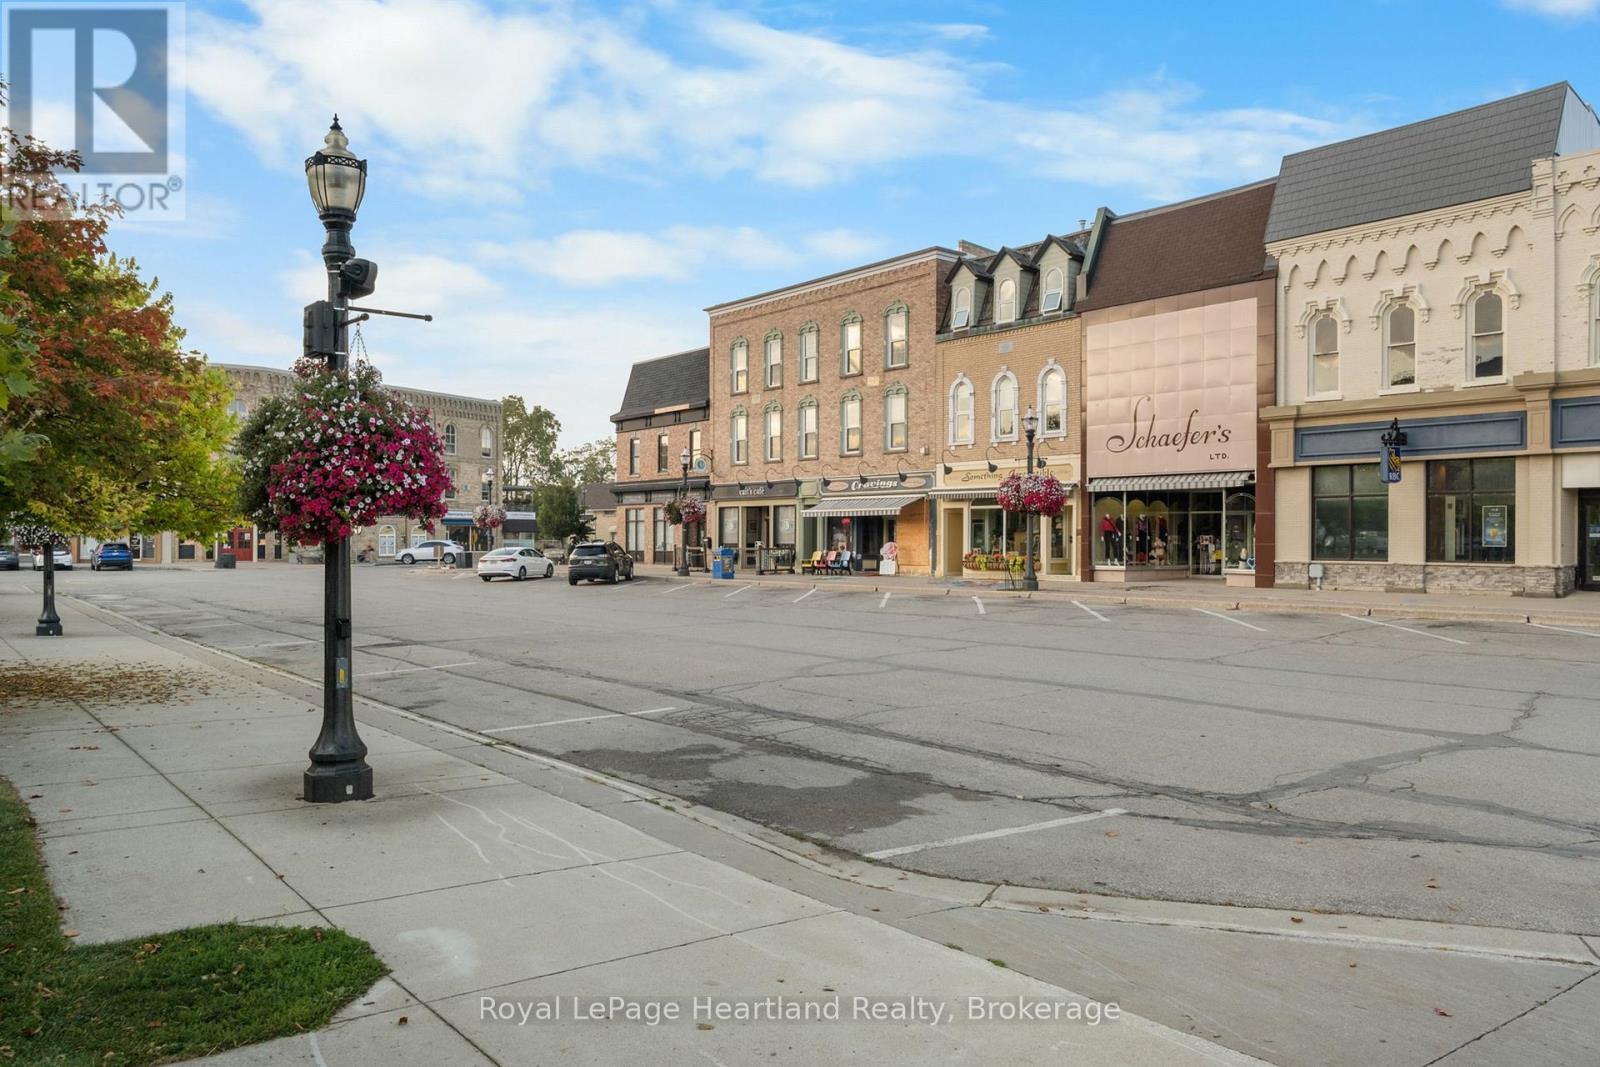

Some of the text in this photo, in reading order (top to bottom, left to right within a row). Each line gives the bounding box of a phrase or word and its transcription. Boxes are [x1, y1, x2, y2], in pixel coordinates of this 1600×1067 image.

[1105, 395, 1232, 453] Schaefer's
[961, 471, 1003, 482] Something
[1389, 472, 1400, 480] RBC
[850, 479, 898, 491] Cravings
